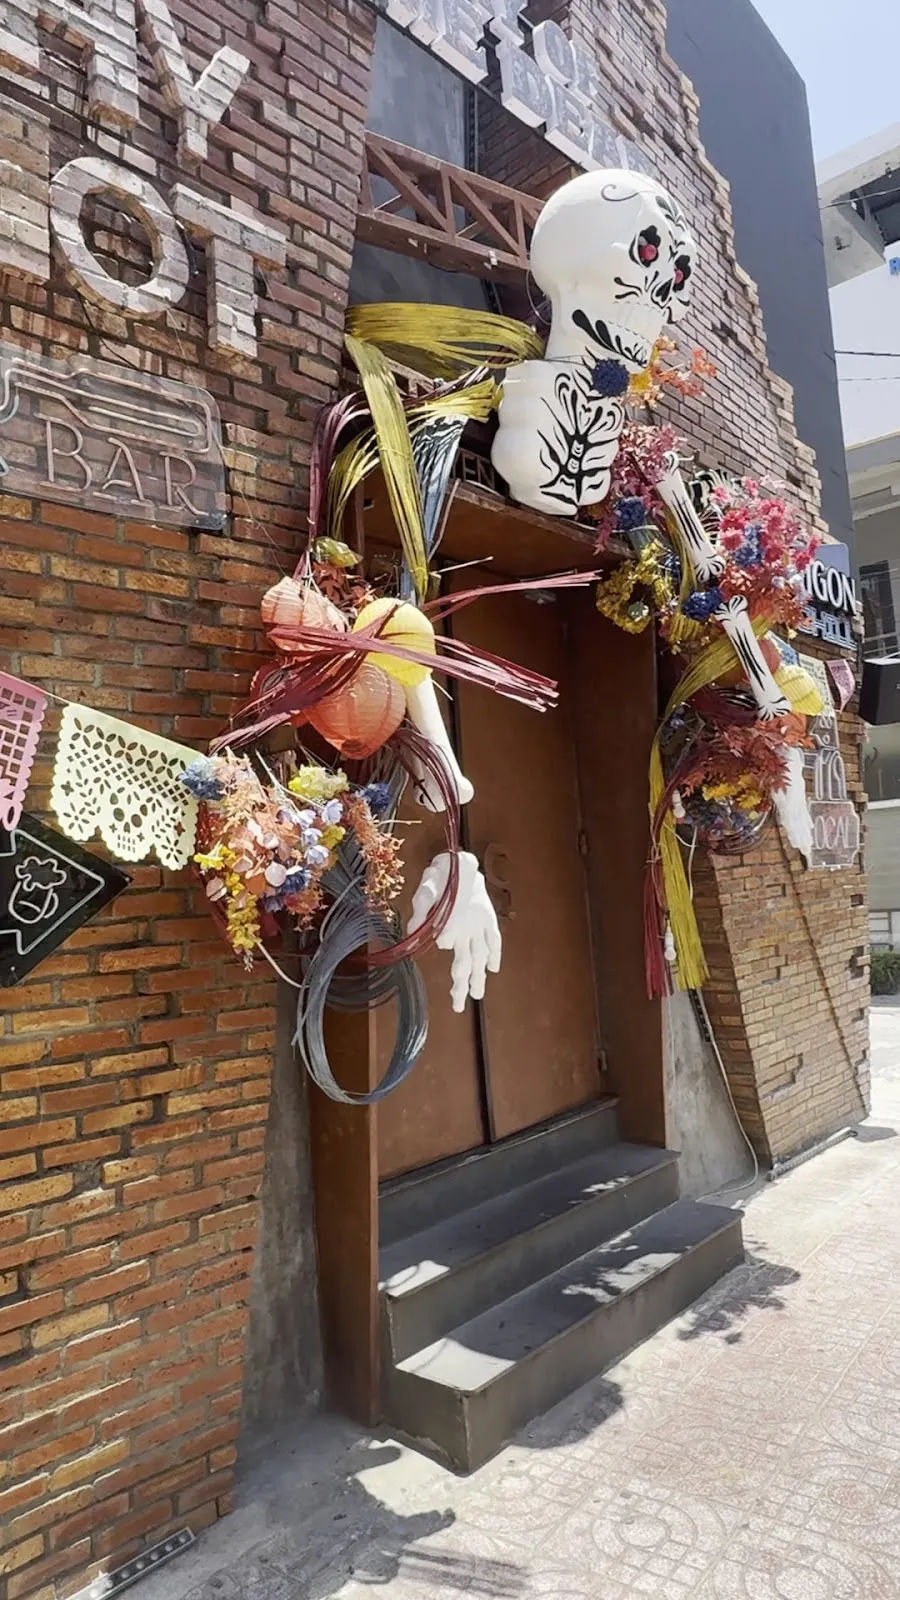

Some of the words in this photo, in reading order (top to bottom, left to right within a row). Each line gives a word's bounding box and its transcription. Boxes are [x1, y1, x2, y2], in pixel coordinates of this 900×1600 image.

[33, 412, 210, 517] BAR
[802, 561, 857, 615] IGON
[811, 814, 859, 850] OCAL
